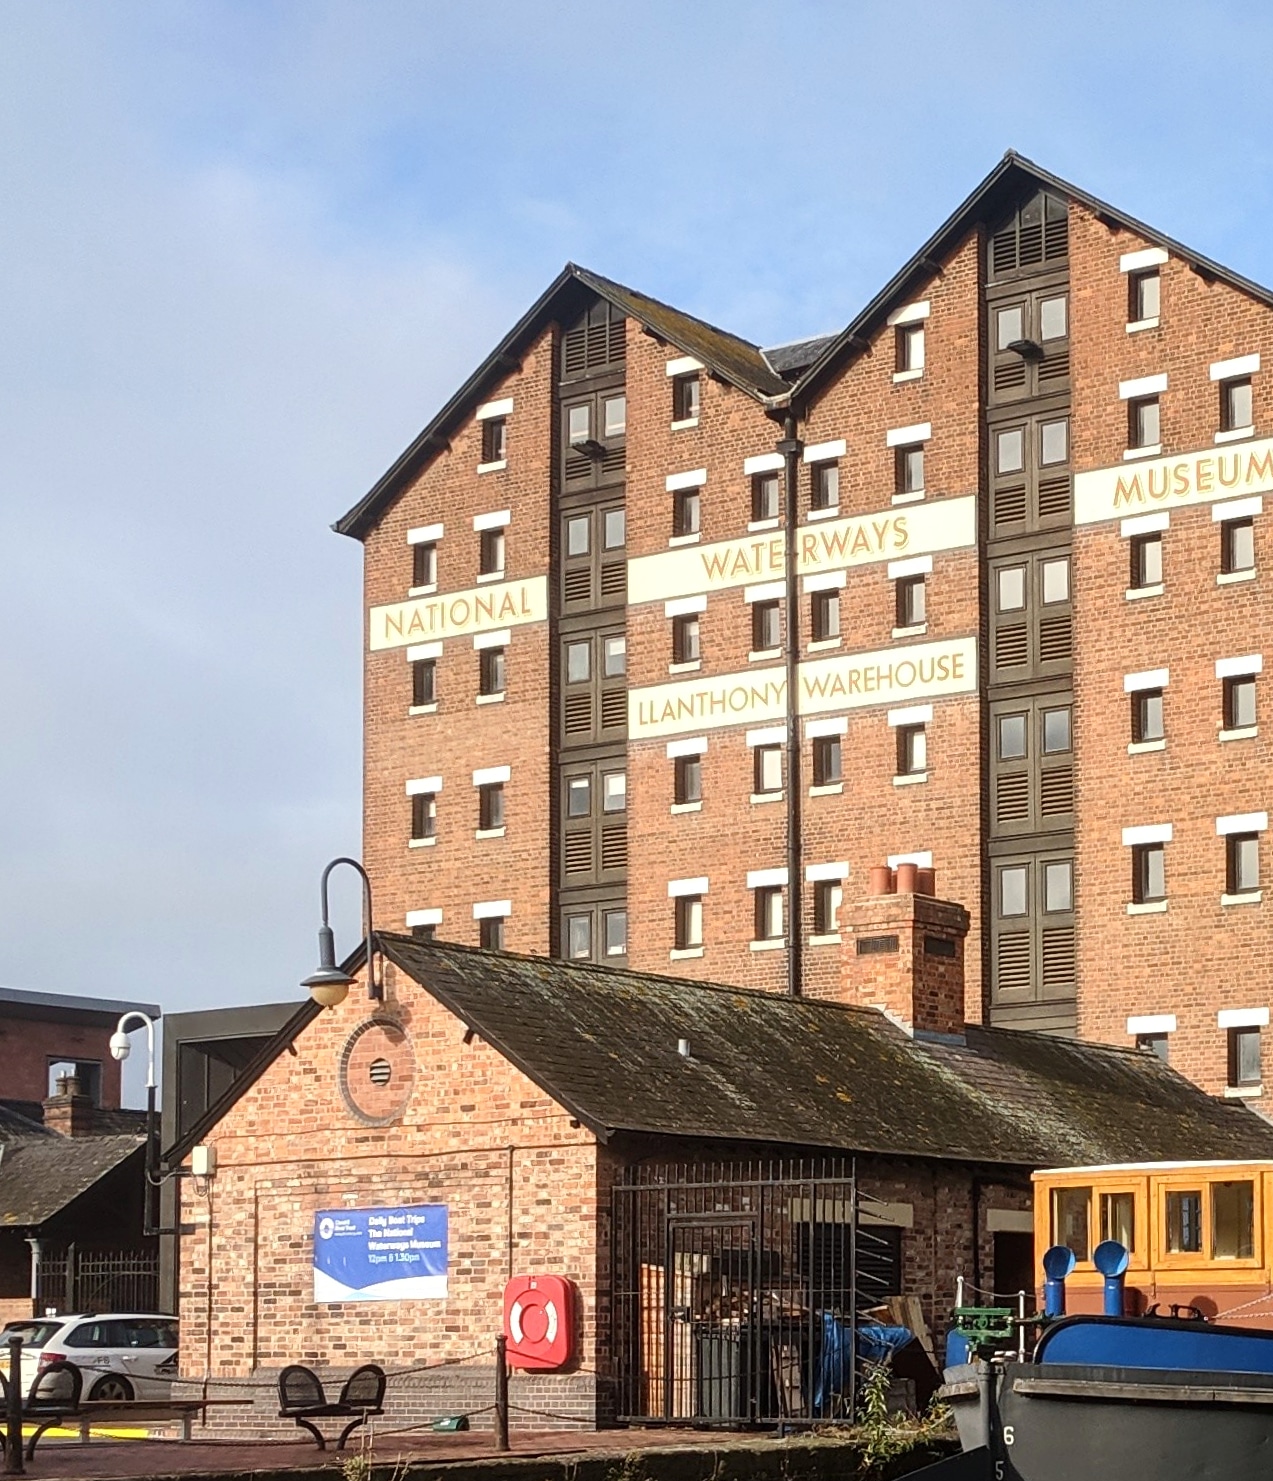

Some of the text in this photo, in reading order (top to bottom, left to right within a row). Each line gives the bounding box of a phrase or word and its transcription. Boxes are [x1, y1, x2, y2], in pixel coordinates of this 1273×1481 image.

[701, 516, 909, 581] WATERWAYS
[385, 586, 533, 641] NATIONAL
[638, 652, 965, 726] LLANTHONY WAREHOUSE
[368, 1215, 425, 1227] Daily Boat Trips
[368, 1229, 383, 1238] The
[383, 1227, 414, 1238] National
[368, 1239, 442, 1251] Waterways Museum
[1003, 1426, 1015, 1445] 6
[995, 1461, 1004, 1480] 5
